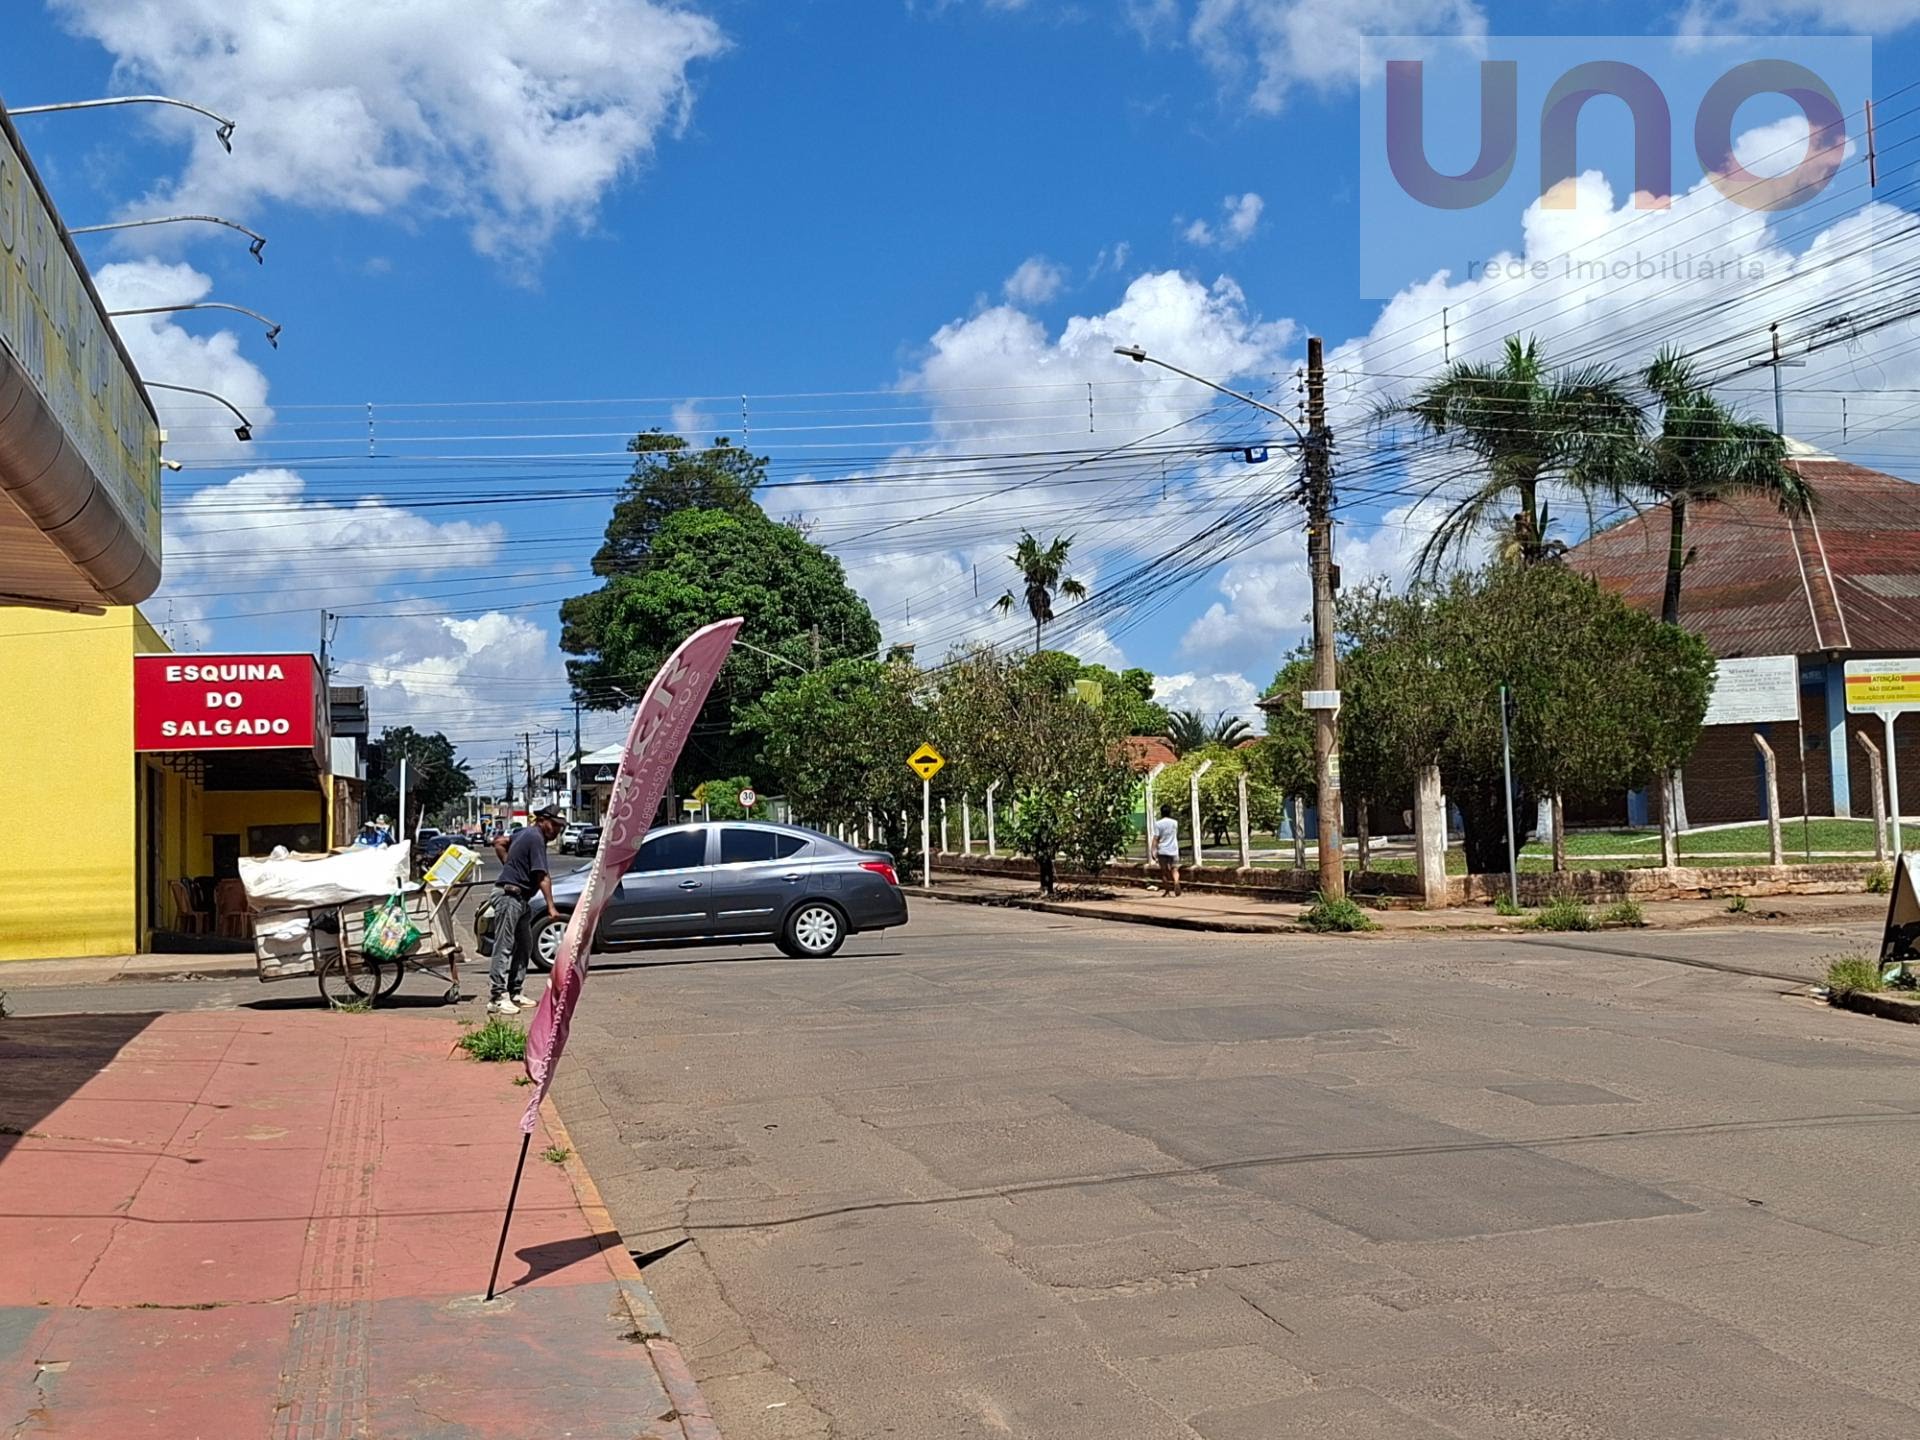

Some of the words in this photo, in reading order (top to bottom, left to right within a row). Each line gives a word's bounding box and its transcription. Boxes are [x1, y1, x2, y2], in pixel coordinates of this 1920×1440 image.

[165, 664, 284, 682] ESQUINA
[206, 692, 243, 708] DO
[161, 718, 290, 736] SALGADO
[742, 791, 754, 801] 30
